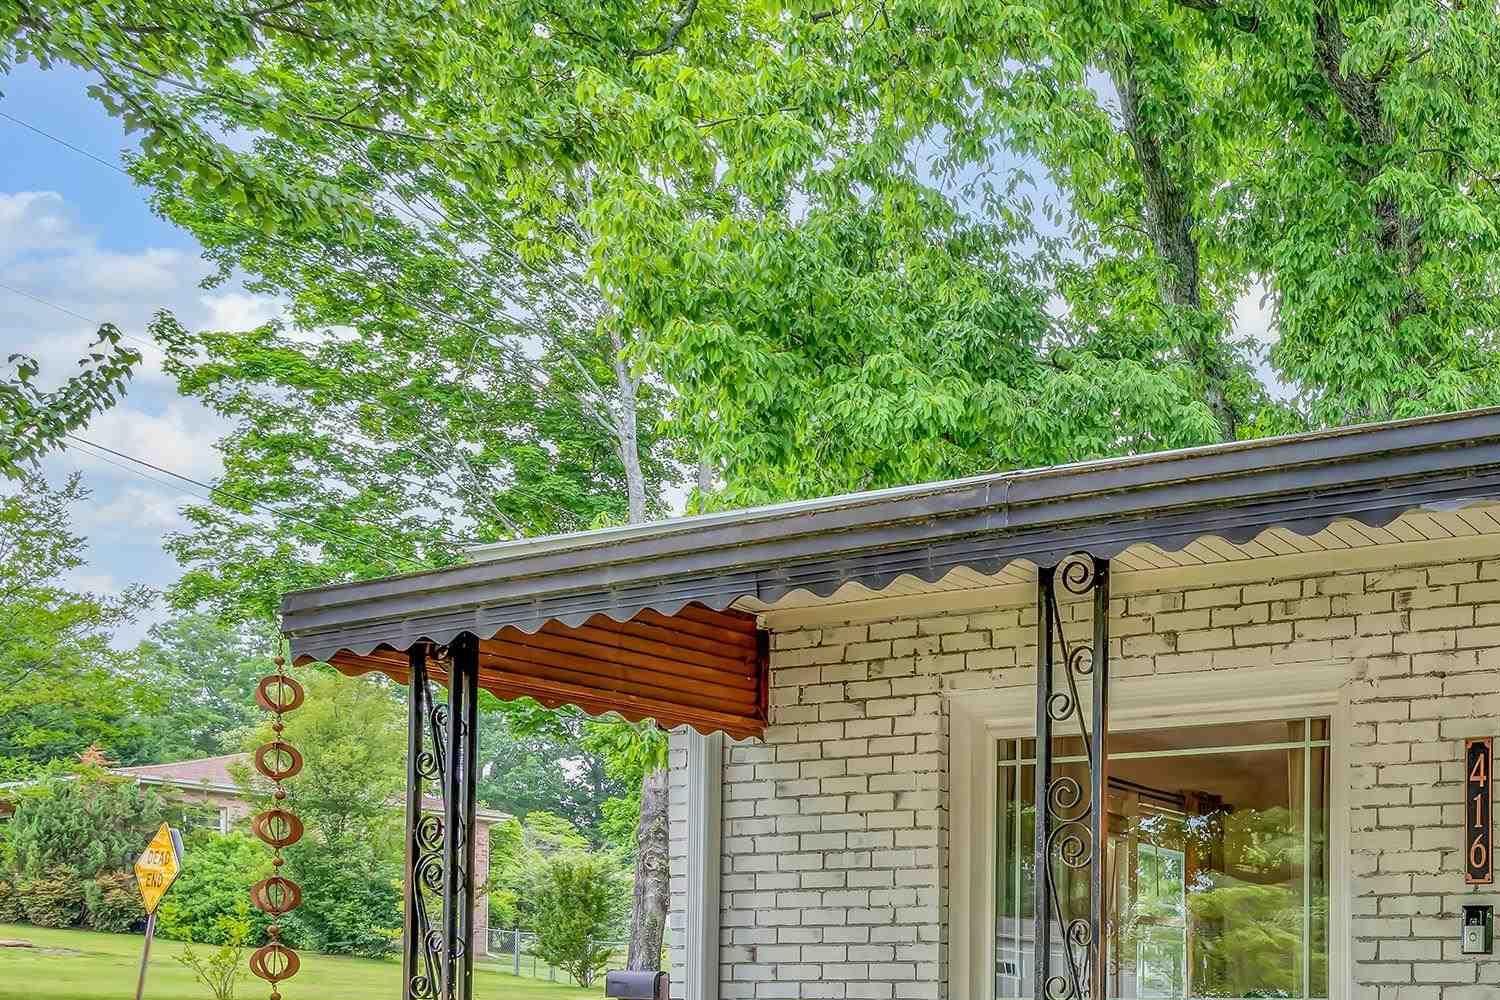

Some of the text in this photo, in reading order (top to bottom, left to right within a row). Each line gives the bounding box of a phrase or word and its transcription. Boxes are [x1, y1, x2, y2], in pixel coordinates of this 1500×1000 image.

[1470, 752, 1487, 869] 416
[146, 849, 170, 865] DEAD
[145, 872, 163, 888] END
